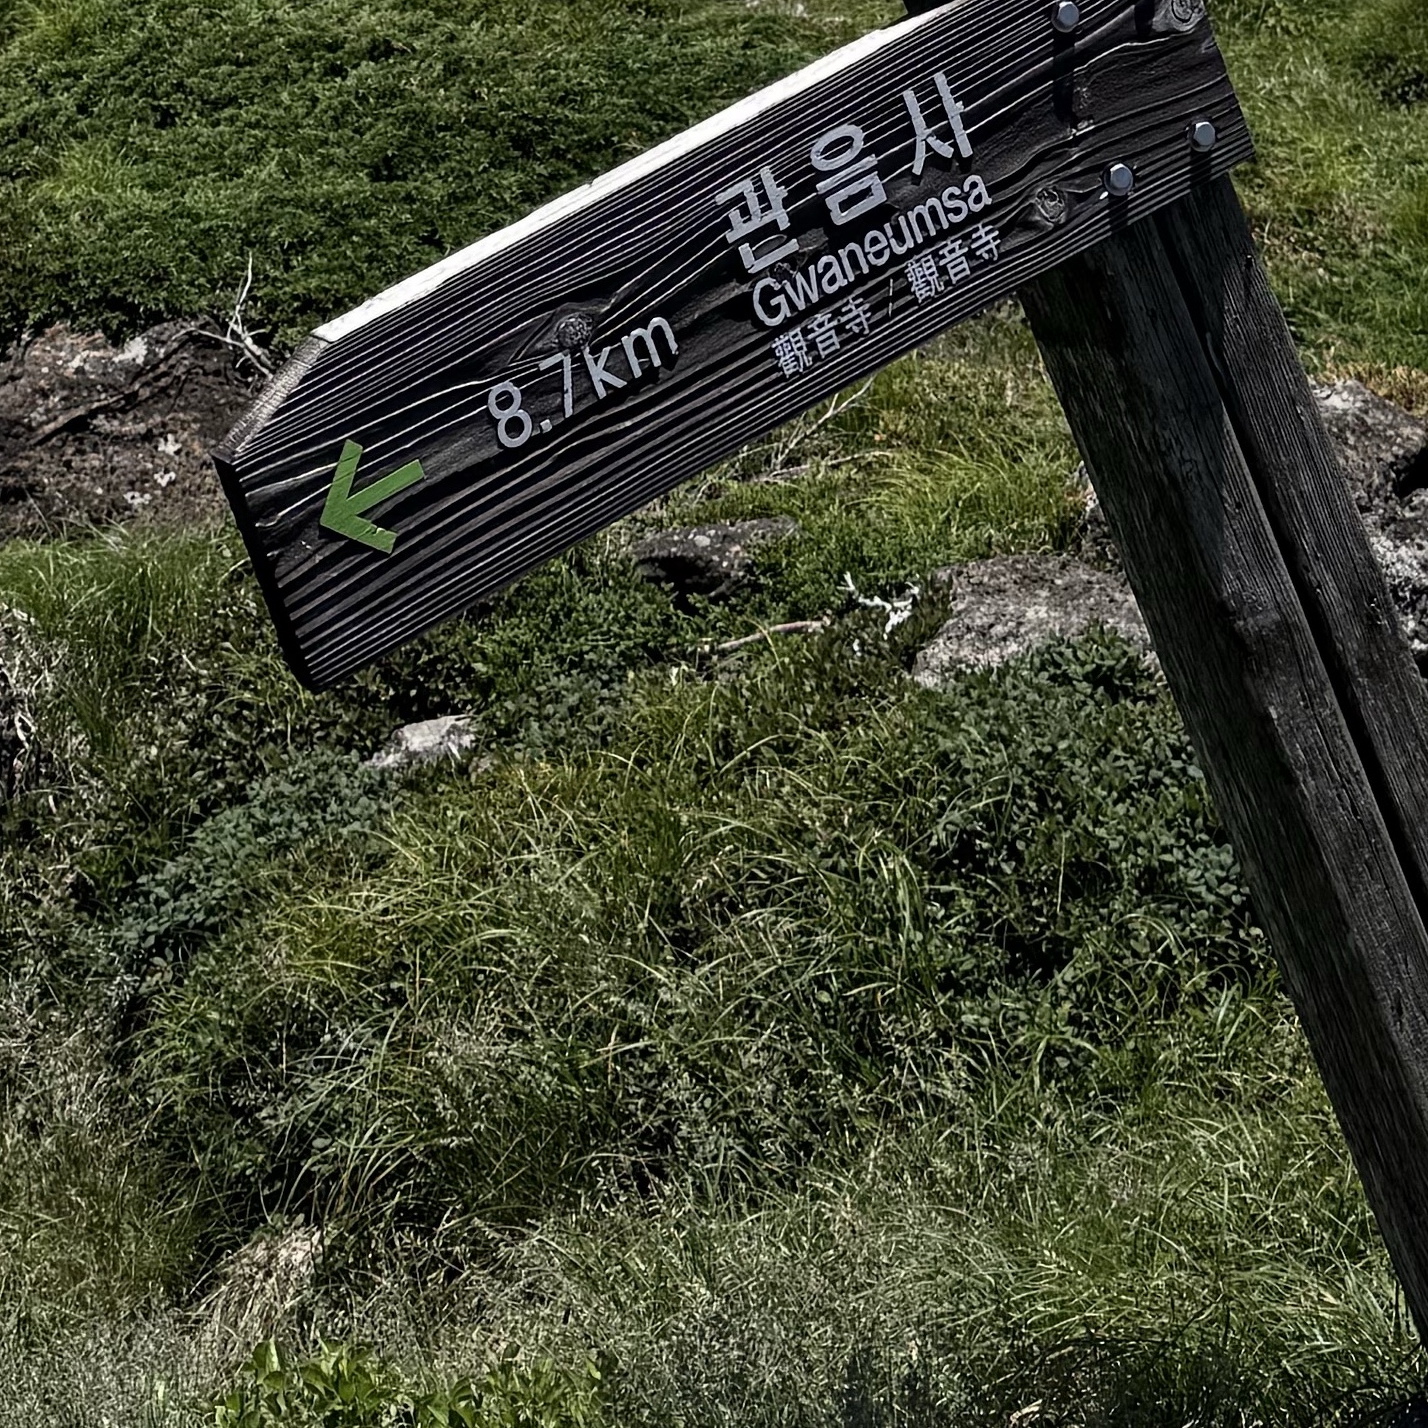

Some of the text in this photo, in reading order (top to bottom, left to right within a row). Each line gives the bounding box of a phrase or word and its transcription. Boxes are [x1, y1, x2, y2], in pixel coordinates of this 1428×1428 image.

[715, 72, 972, 274] 관음사
[753, 175, 992, 327] Gwaneumsa
[772, 297, 871, 378] 觀音寺
[905, 223, 1002, 304] 觀音寺
[488, 316, 679, 448] 8.7km
